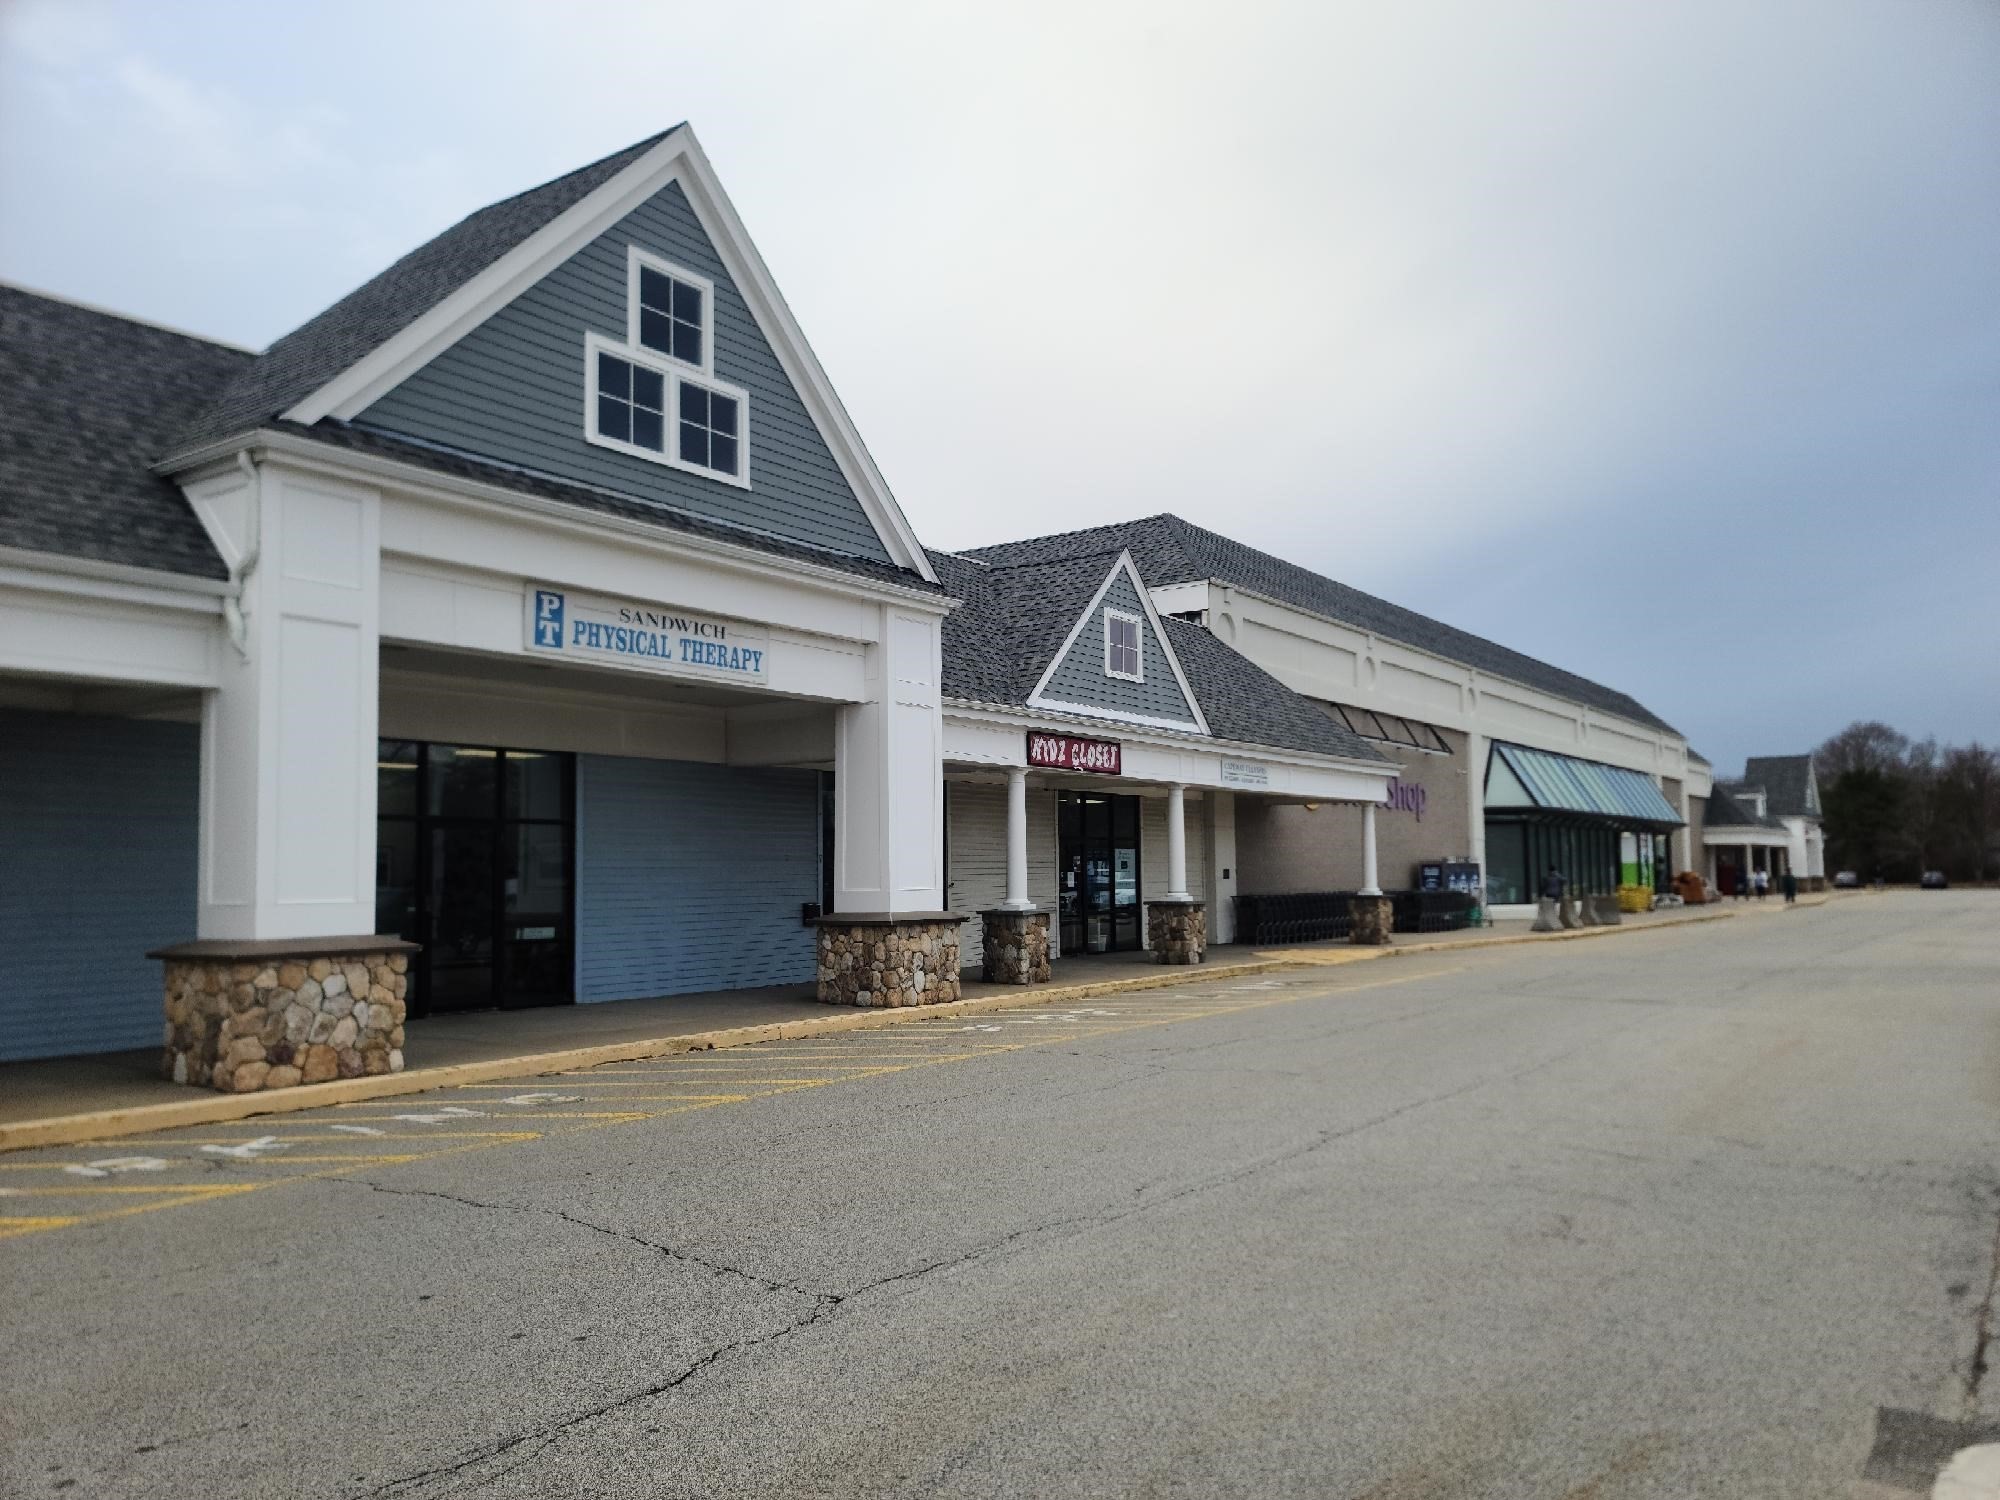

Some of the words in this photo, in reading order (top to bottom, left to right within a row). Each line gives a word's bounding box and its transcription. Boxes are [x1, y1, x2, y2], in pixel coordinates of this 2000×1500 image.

[619, 608, 727, 640] SANDWICH
[572, 619, 672, 659] PHYSICAL
[679, 637, 763, 672] THERAPY
[1071, 742, 1118, 769] CLOSET
